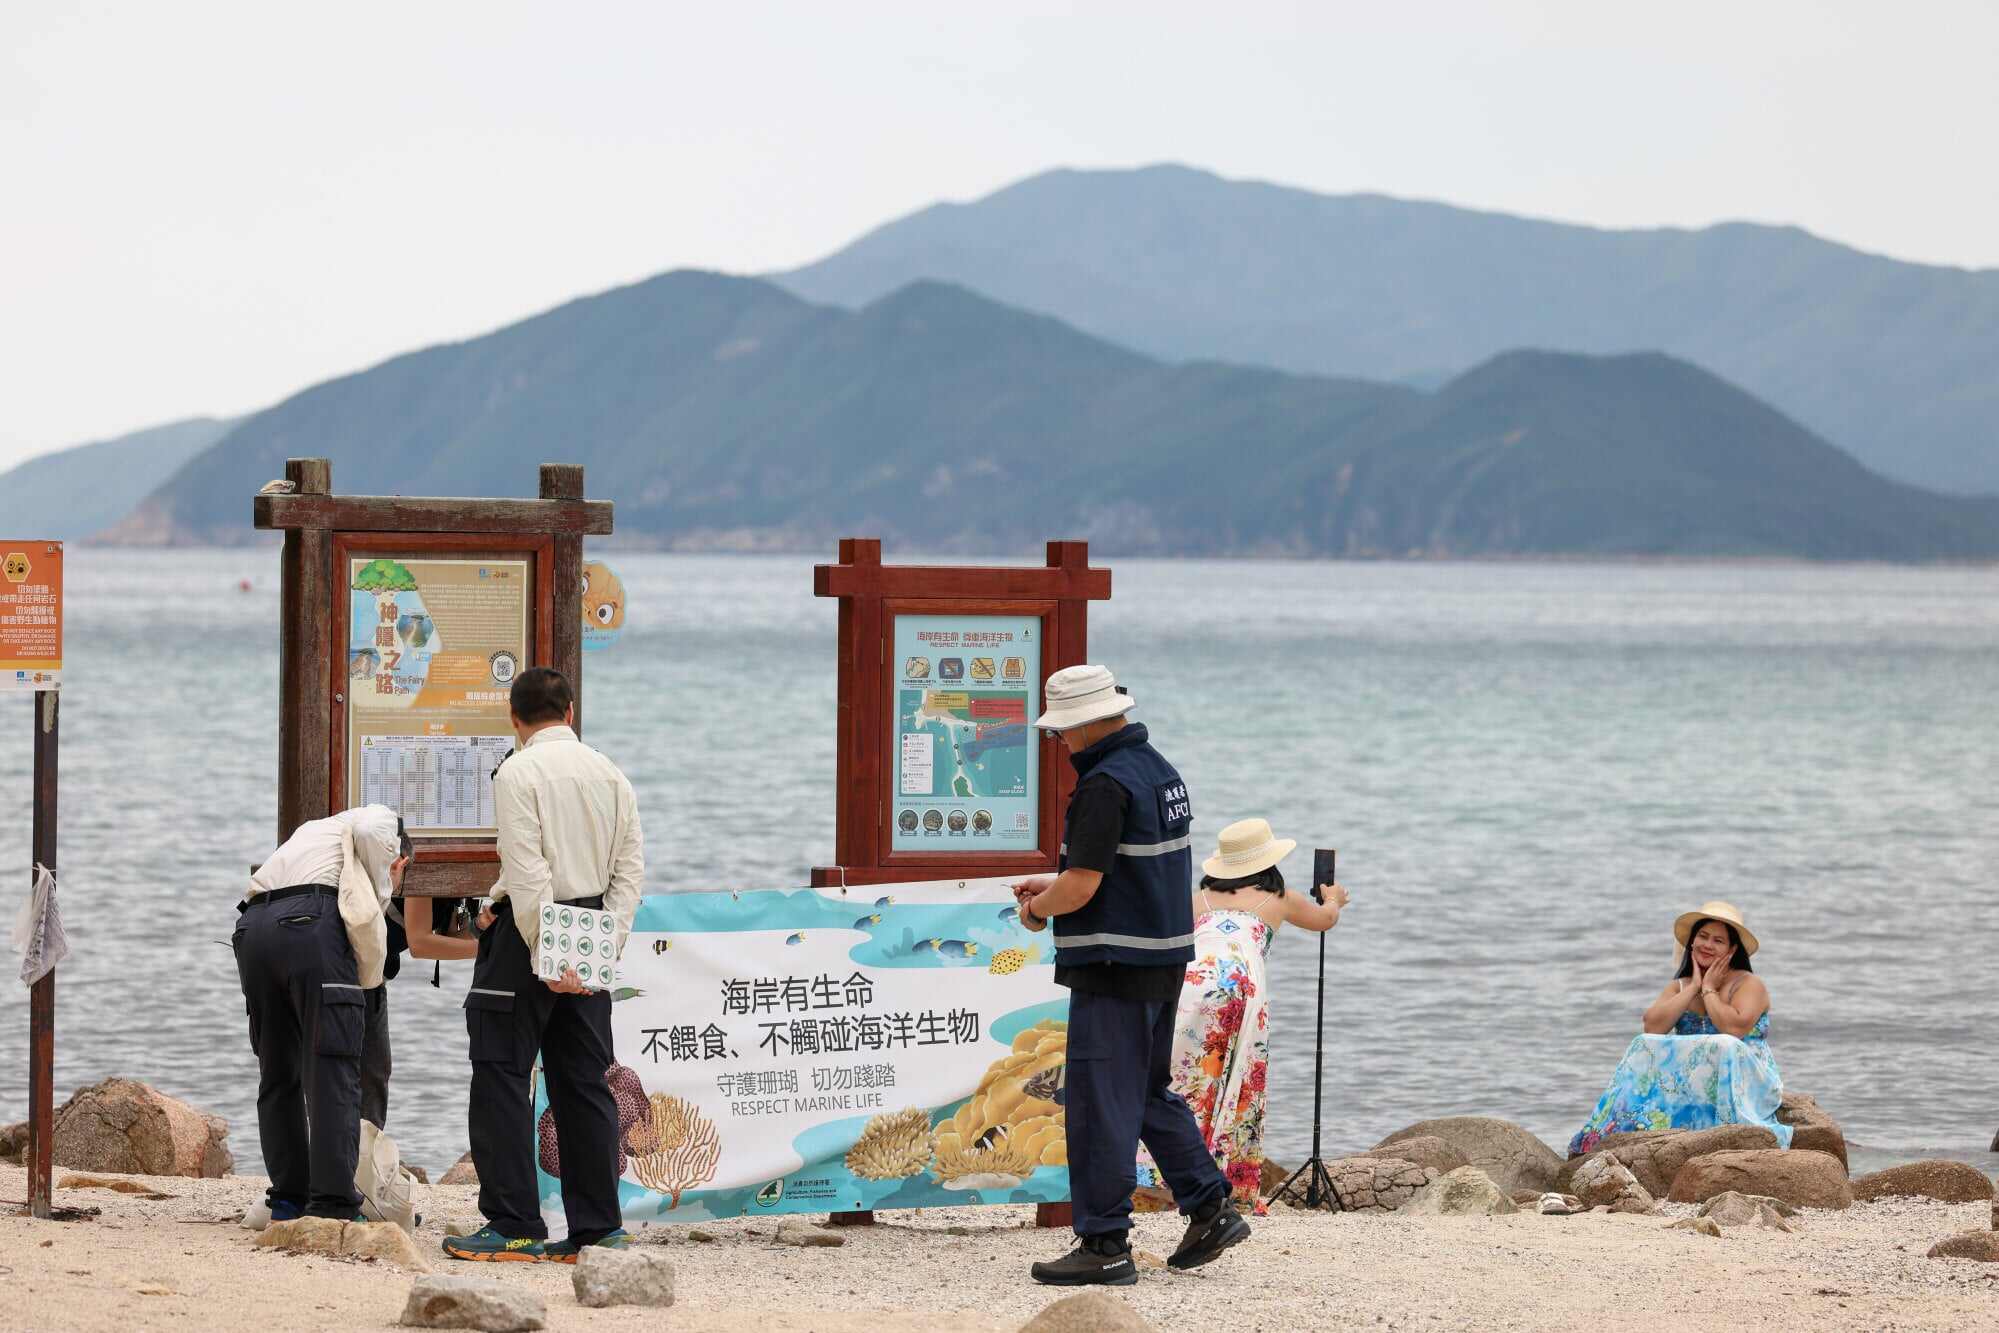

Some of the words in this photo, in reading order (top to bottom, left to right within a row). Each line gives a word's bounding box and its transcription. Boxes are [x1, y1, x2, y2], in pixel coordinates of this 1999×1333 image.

[721, 971, 874, 1016] 海岸有生命
[716, 1069, 799, 1098] 守護珊瑚
[811, 1062, 896, 1091] 切勿踐踏
[731, 1098, 790, 1117] RESPECT
[794, 1095, 852, 1114] MARINE
[856, 1092, 884, 1109] LIFE
[506, 1239, 532, 1250] HOKA
